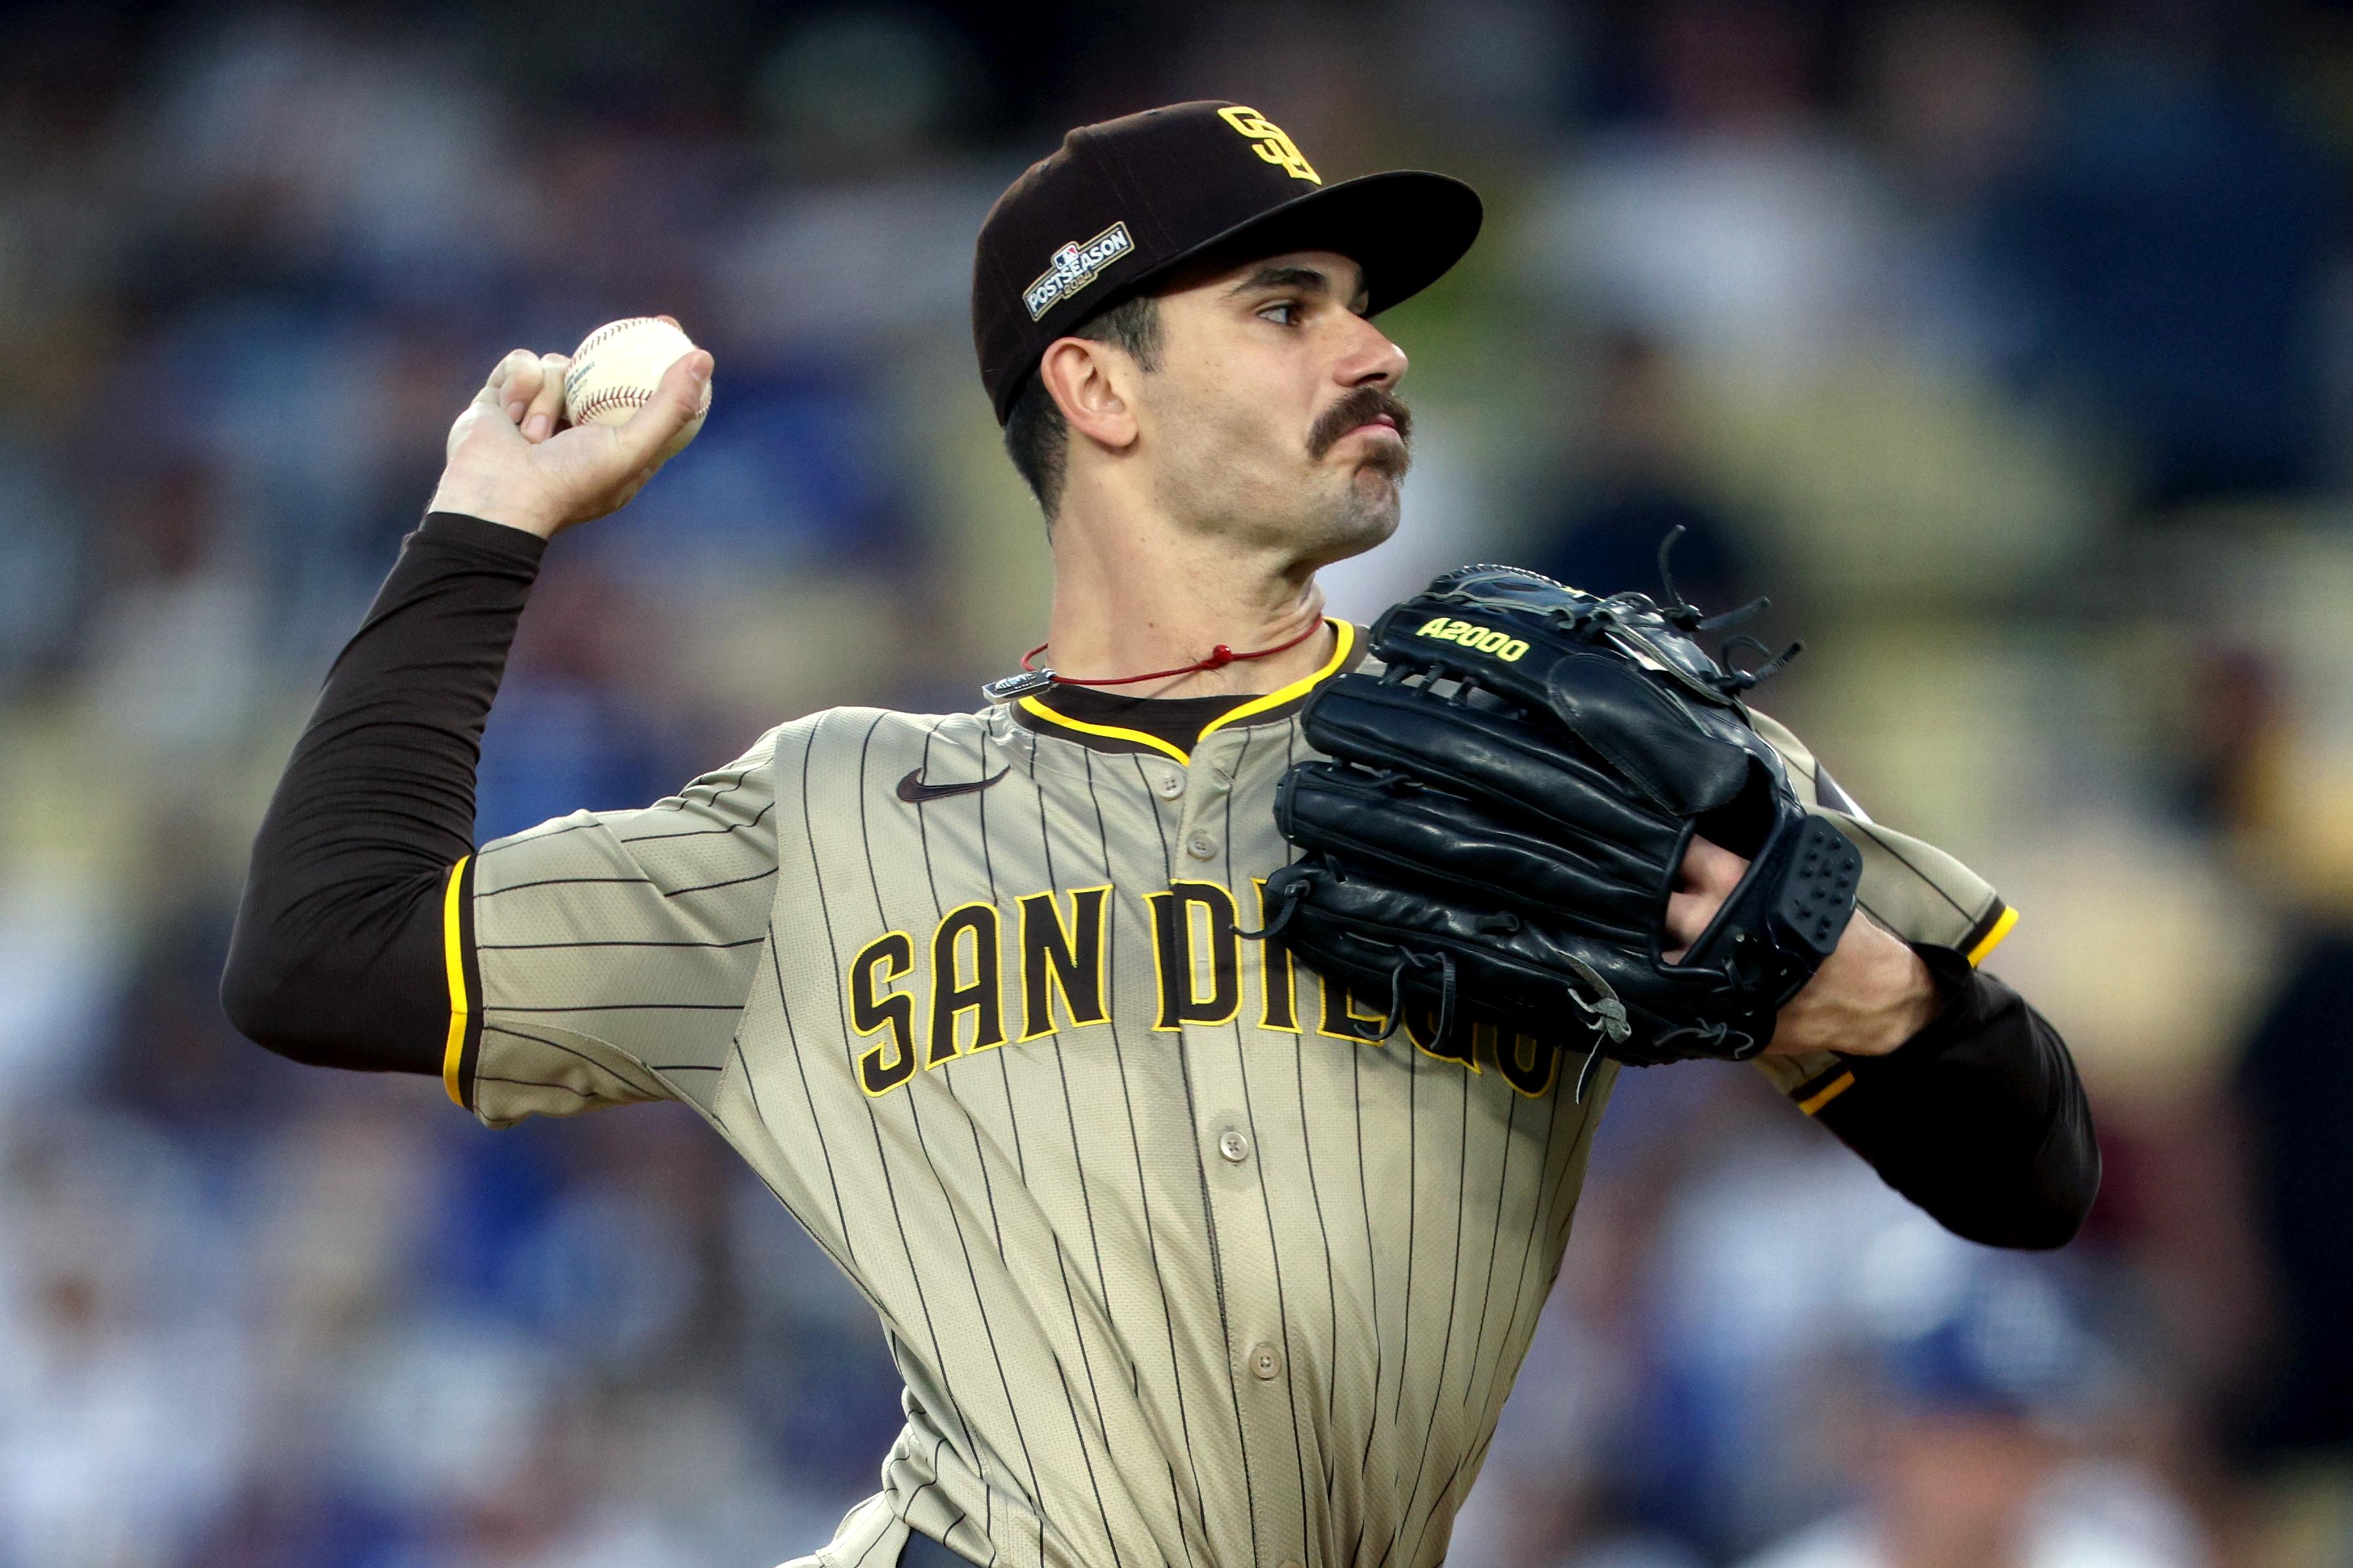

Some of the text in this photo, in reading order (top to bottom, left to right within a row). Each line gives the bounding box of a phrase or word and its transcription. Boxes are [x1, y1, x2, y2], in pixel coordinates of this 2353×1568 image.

[1027, 231, 1128, 313] POSTSEASON
[1415, 617, 1531, 663] A2000
[848, 883, 1114, 1098] SAN
